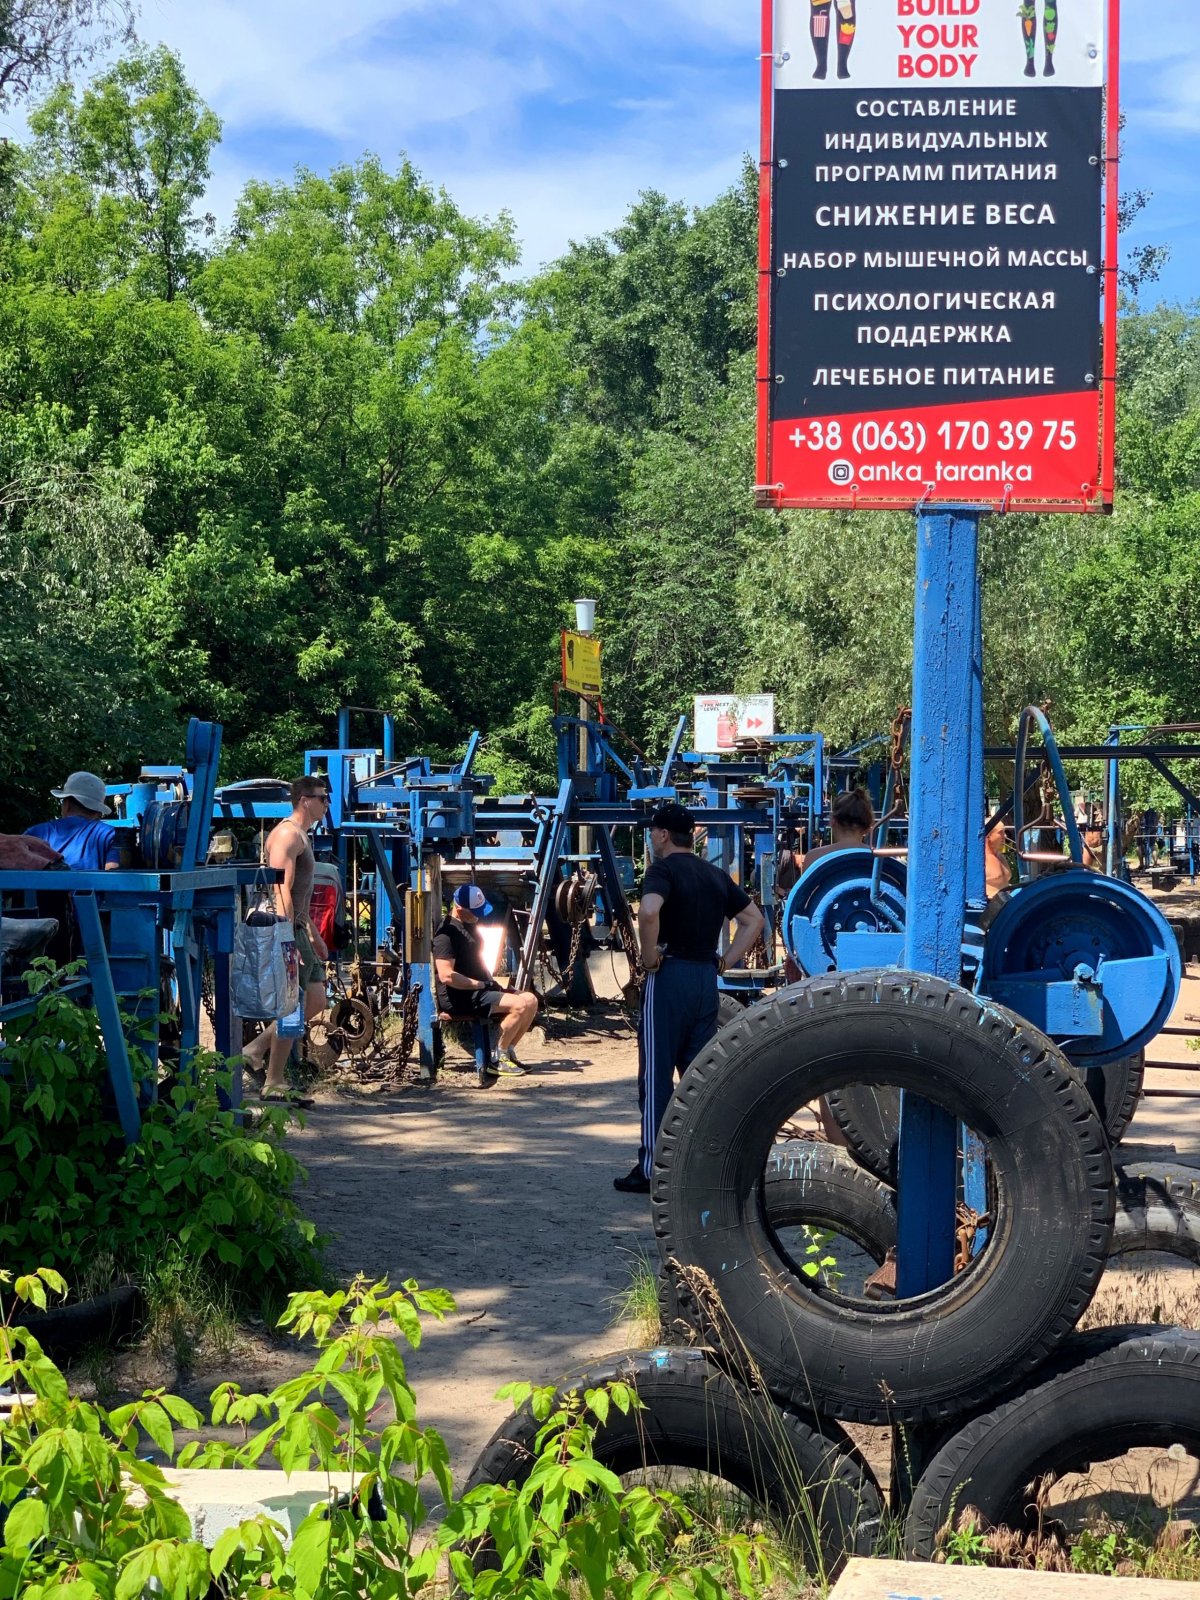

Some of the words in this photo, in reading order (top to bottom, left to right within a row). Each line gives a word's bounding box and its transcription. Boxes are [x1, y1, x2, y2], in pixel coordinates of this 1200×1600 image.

[898, 0, 980, 16] BUILD
[898, 24, 978, 48] YOUR
[898, 54, 976, 78] BODY
[857, 100, 1016, 116] СОСТАВЛЕНИЕ
[826, 132, 1047, 152] ИНДИВИДУАЛЬНЫХ
[816, 165, 943, 181] ПРОГРАММ
[952, 164, 1056, 180] ПИТАНИЯ
[816, 205, 975, 226] СНИЖЕНИЕ
[986, 204, 1055, 224] ВЕСА
[784, 252, 856, 268] НАБОР
[864, 247, 999, 267] МЫШЕЧНОЙ
[1008, 250, 1087, 266] МАССЫ
[815, 292, 1054, 311] ПСИХОЛОГИЧЕСКАЯ
[858, 325, 1011, 347] ПОДДЕРЖКА
[813, 368, 934, 385] ЛЕЧЕБНОЕ
[944, 367, 1054, 384] ПИТАНИЕ
[789, 421, 842, 450] +38
[852, 421, 926, 454] (063)
[937, 421, 989, 450] 170
[997, 421, 1033, 450] 39
[1043, 421, 1076, 450] 75
[859, 461, 1031, 485] anka_taranka
